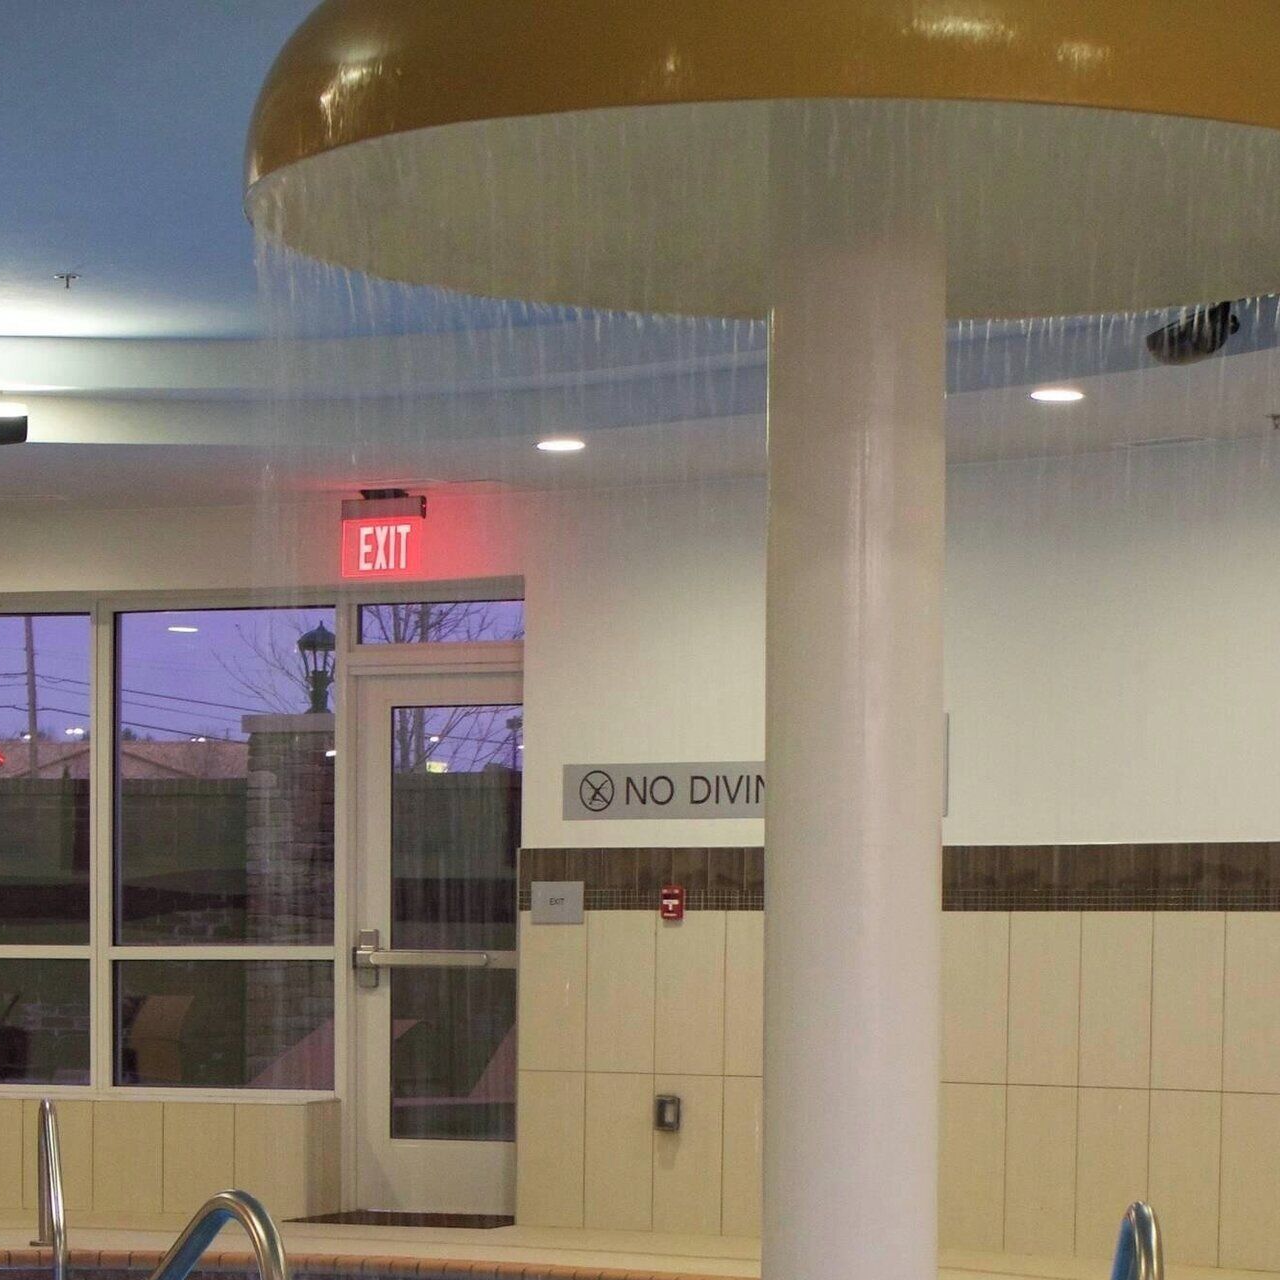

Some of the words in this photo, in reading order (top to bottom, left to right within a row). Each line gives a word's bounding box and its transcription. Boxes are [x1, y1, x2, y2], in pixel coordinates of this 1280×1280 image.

[359, 524, 411, 571] EXIT
[626, 776, 674, 805] NO
[690, 775, 765, 804] DIVI
